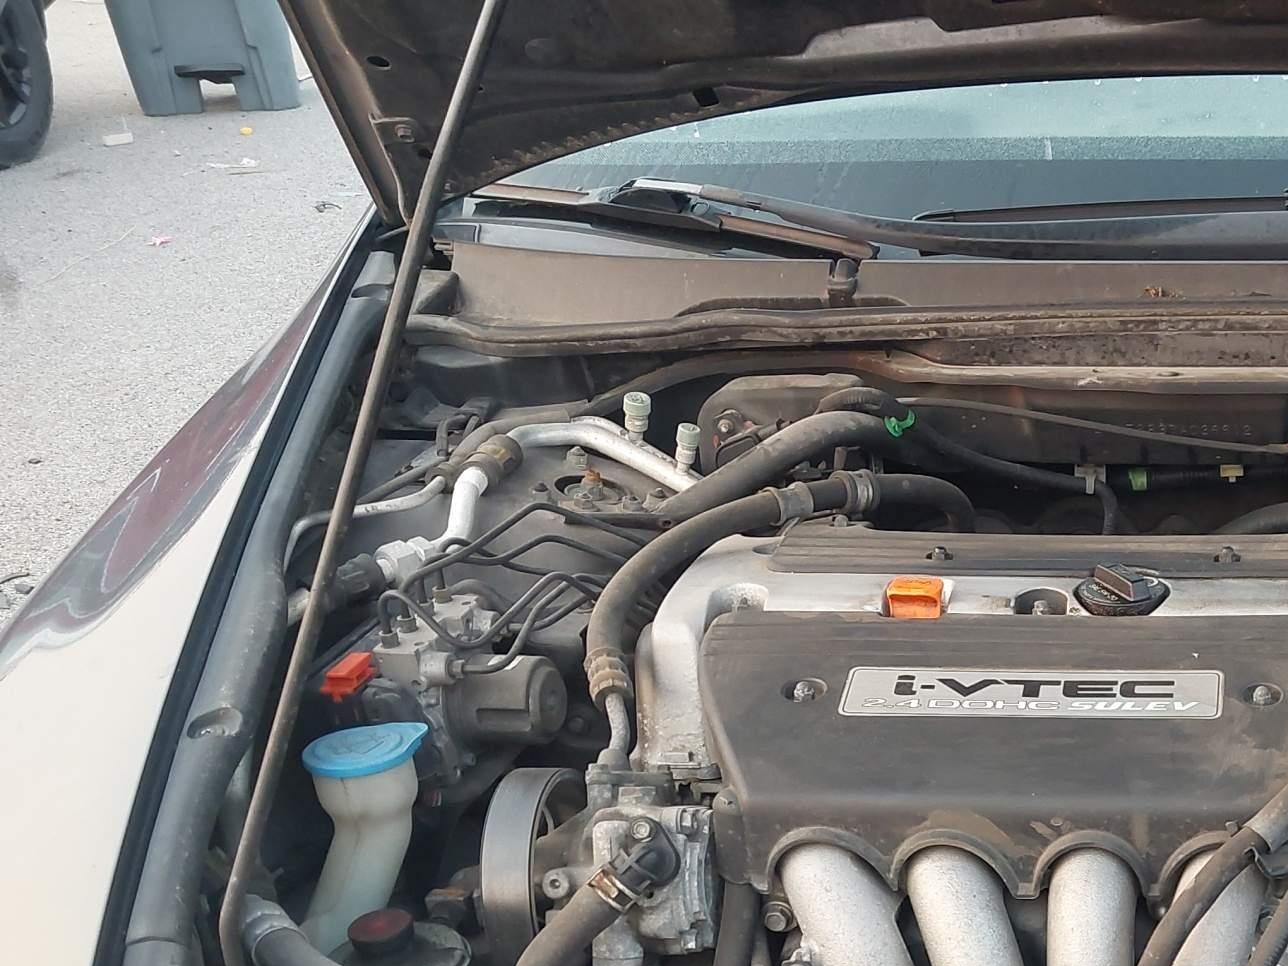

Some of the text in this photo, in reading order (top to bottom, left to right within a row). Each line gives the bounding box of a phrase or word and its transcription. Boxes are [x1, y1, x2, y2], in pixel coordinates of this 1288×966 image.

[893, 674, 1175, 698] i-VTEC
[862, 697, 1200, 711] 2.4 DOHC SULEV
